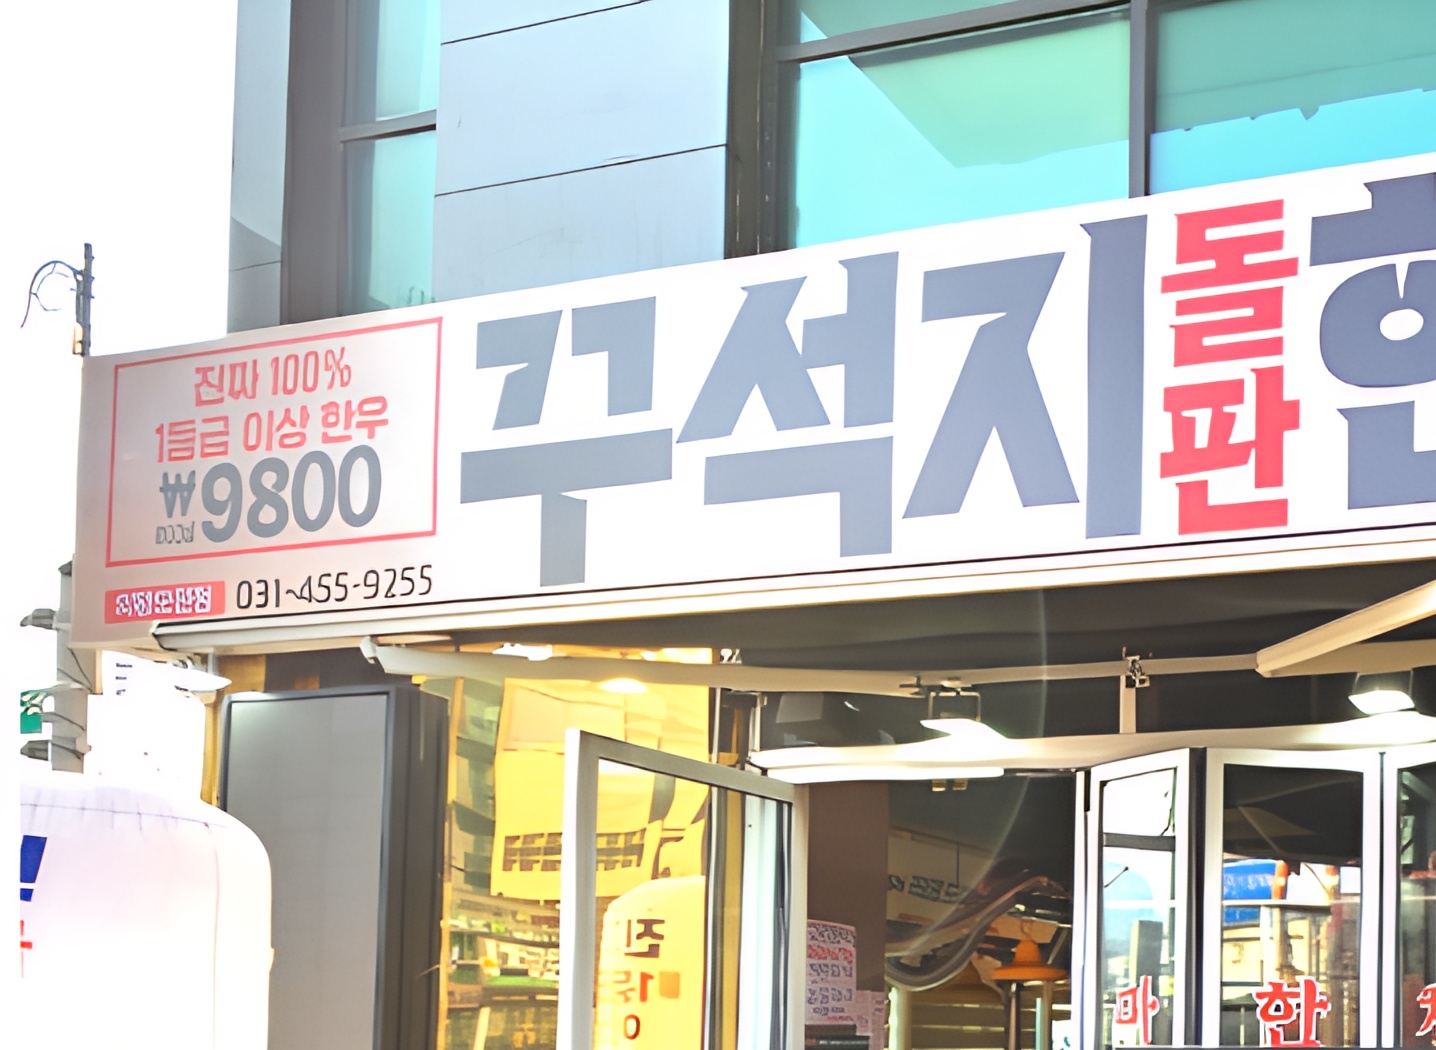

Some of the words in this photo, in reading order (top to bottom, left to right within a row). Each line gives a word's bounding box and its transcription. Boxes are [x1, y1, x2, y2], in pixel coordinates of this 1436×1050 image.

[195, 359, 259, 407] 진짜
[270, 347, 352, 396] 100%
[460, 214, 1148, 587] 꾸석지
[155, 416, 230, 463] 1등급
[243, 405, 310, 452] 이상
[321, 396, 389, 444] 한우
